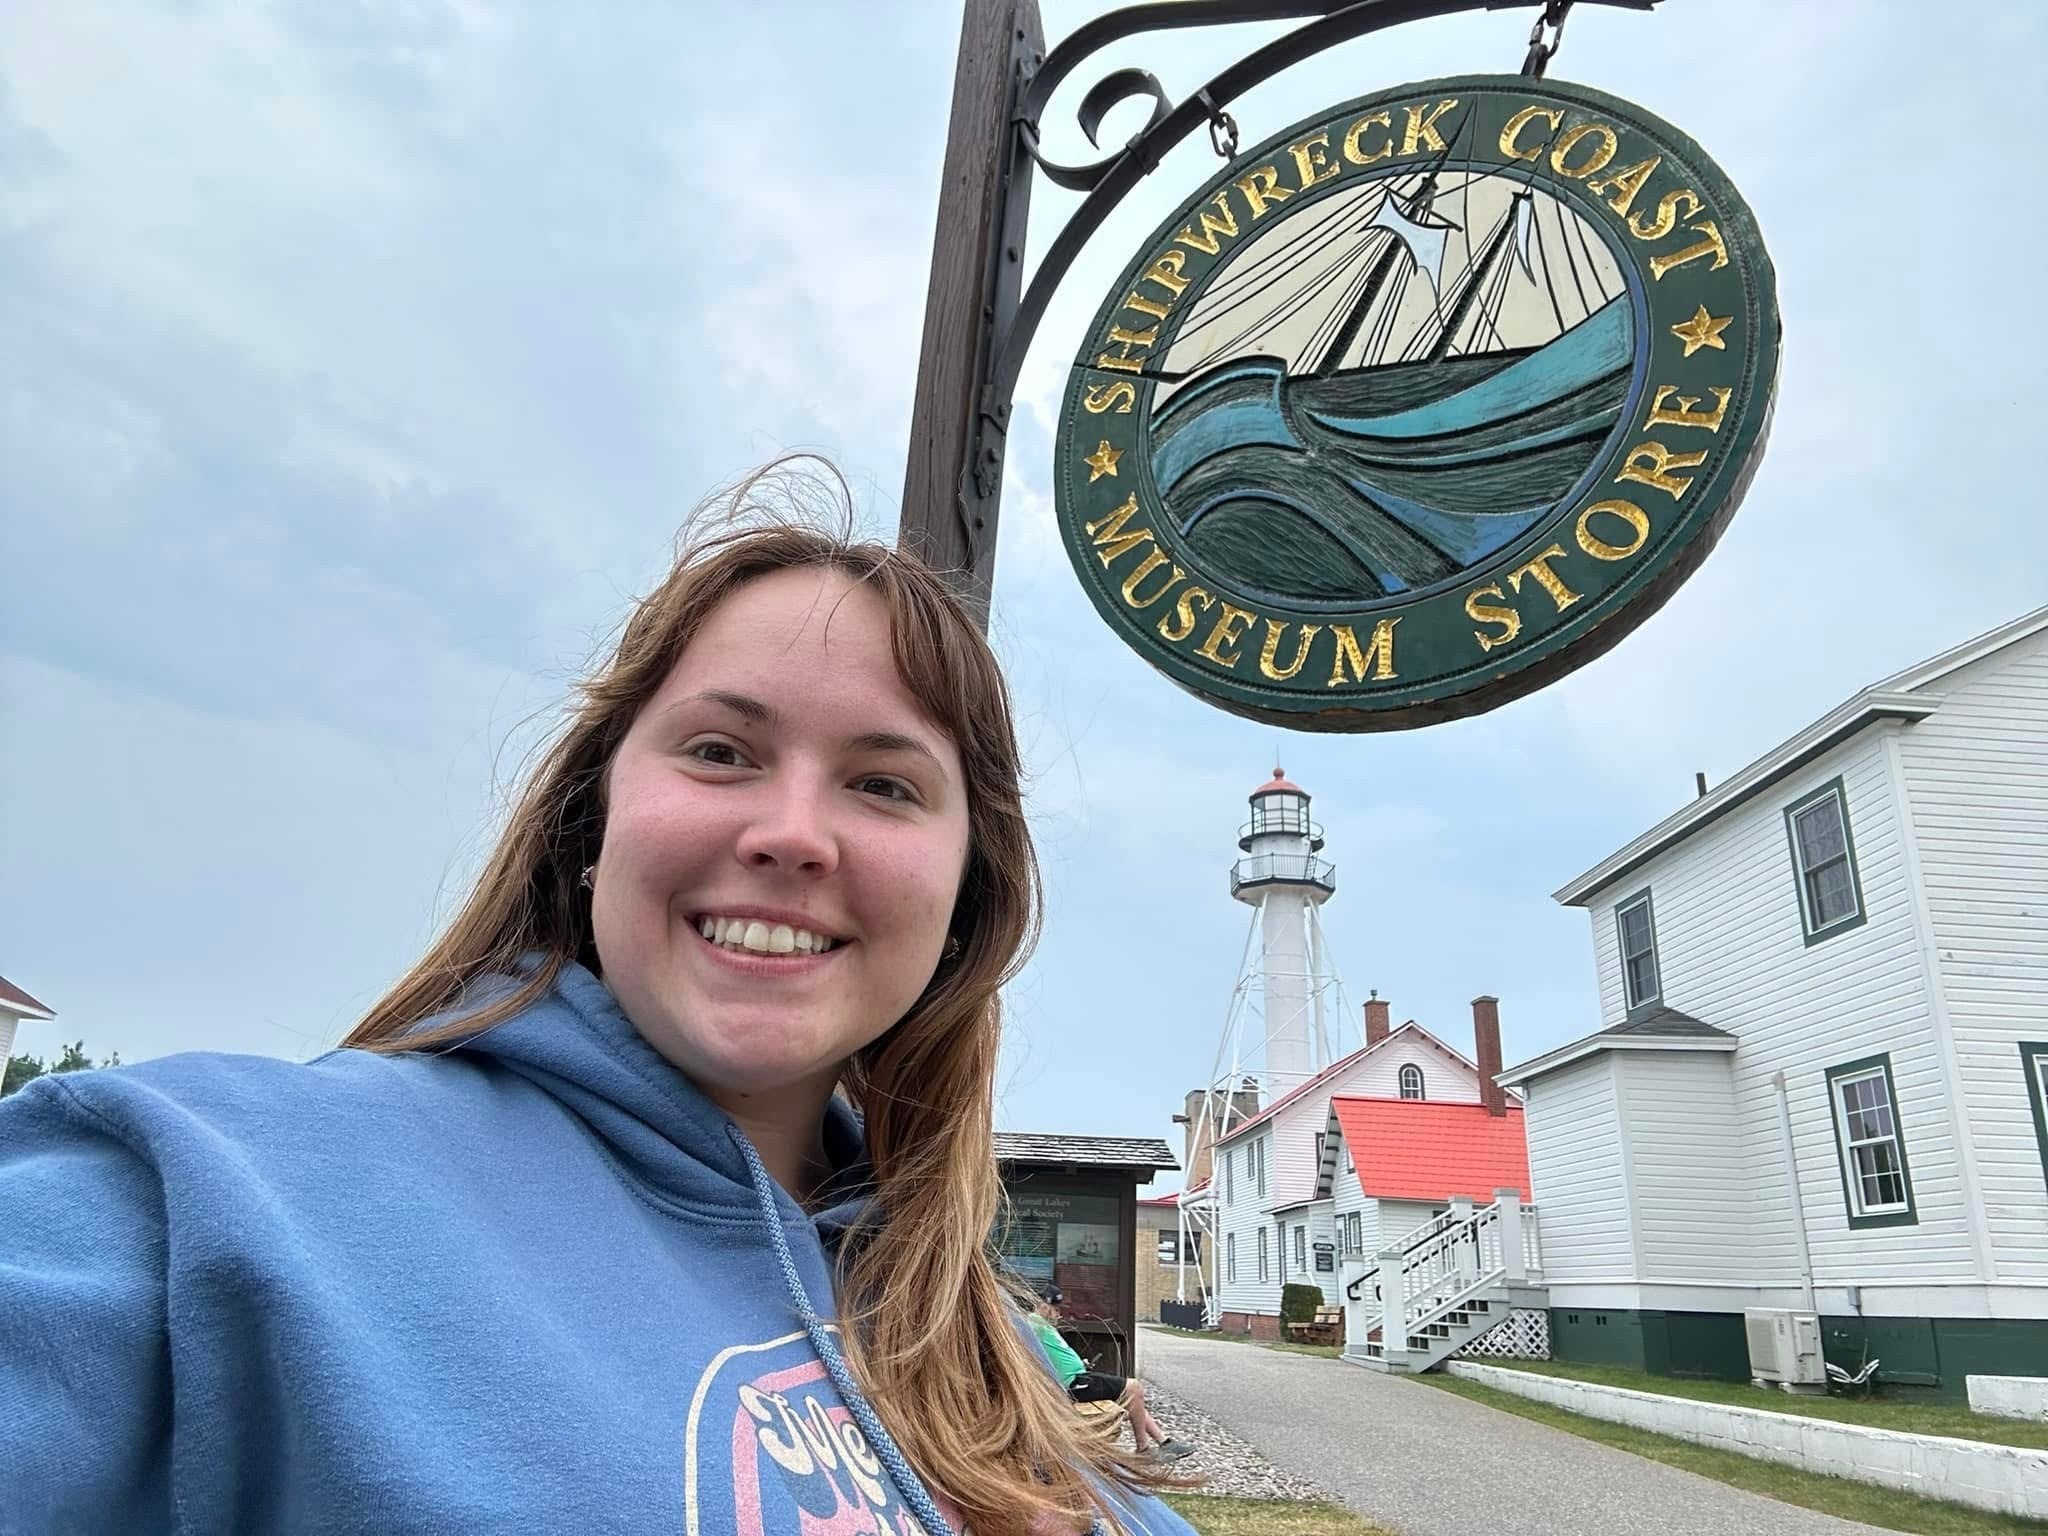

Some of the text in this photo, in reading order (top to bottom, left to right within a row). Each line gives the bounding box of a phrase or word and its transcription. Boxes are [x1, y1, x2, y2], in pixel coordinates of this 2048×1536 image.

[1084, 98, 1729, 414] SHIPWRECK COAST
[1086, 384, 1733, 687] MUSEUM STORE
